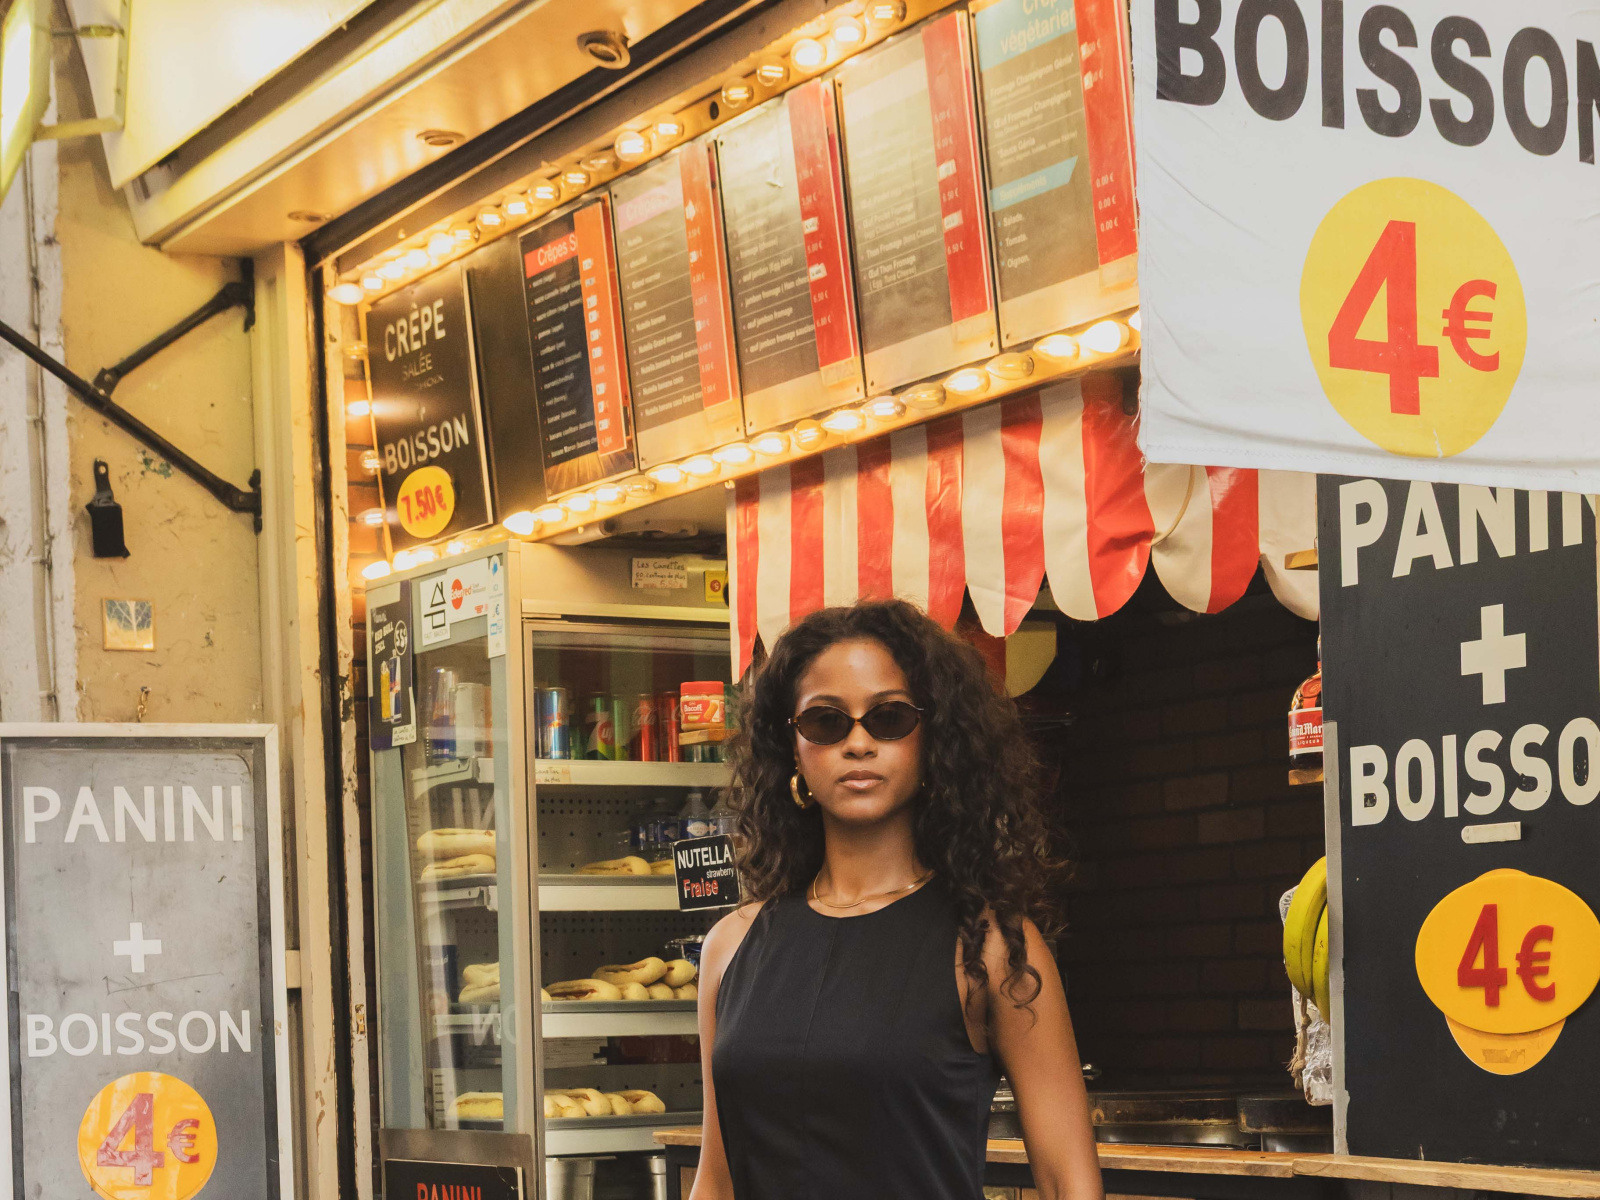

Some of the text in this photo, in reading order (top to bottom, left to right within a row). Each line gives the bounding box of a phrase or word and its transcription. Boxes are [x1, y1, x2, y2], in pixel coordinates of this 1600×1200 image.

[384, 299, 446, 362] CRÊPE
[1328, 220, 1500, 415] 4€
[384, 414, 469, 475] BOISSON
[400, 484, 447, 525] 7.50€
[22, 785, 244, 844] PANINI
[677, 844, 733, 870] NUTELLA
[706, 867, 734, 879] strawberry
[683, 878, 719, 899] Fraise
[1457, 903, 1556, 1007] 4€
[26, 1009, 251, 1058] BOISSON
[97, 1093, 200, 1187] 4€
